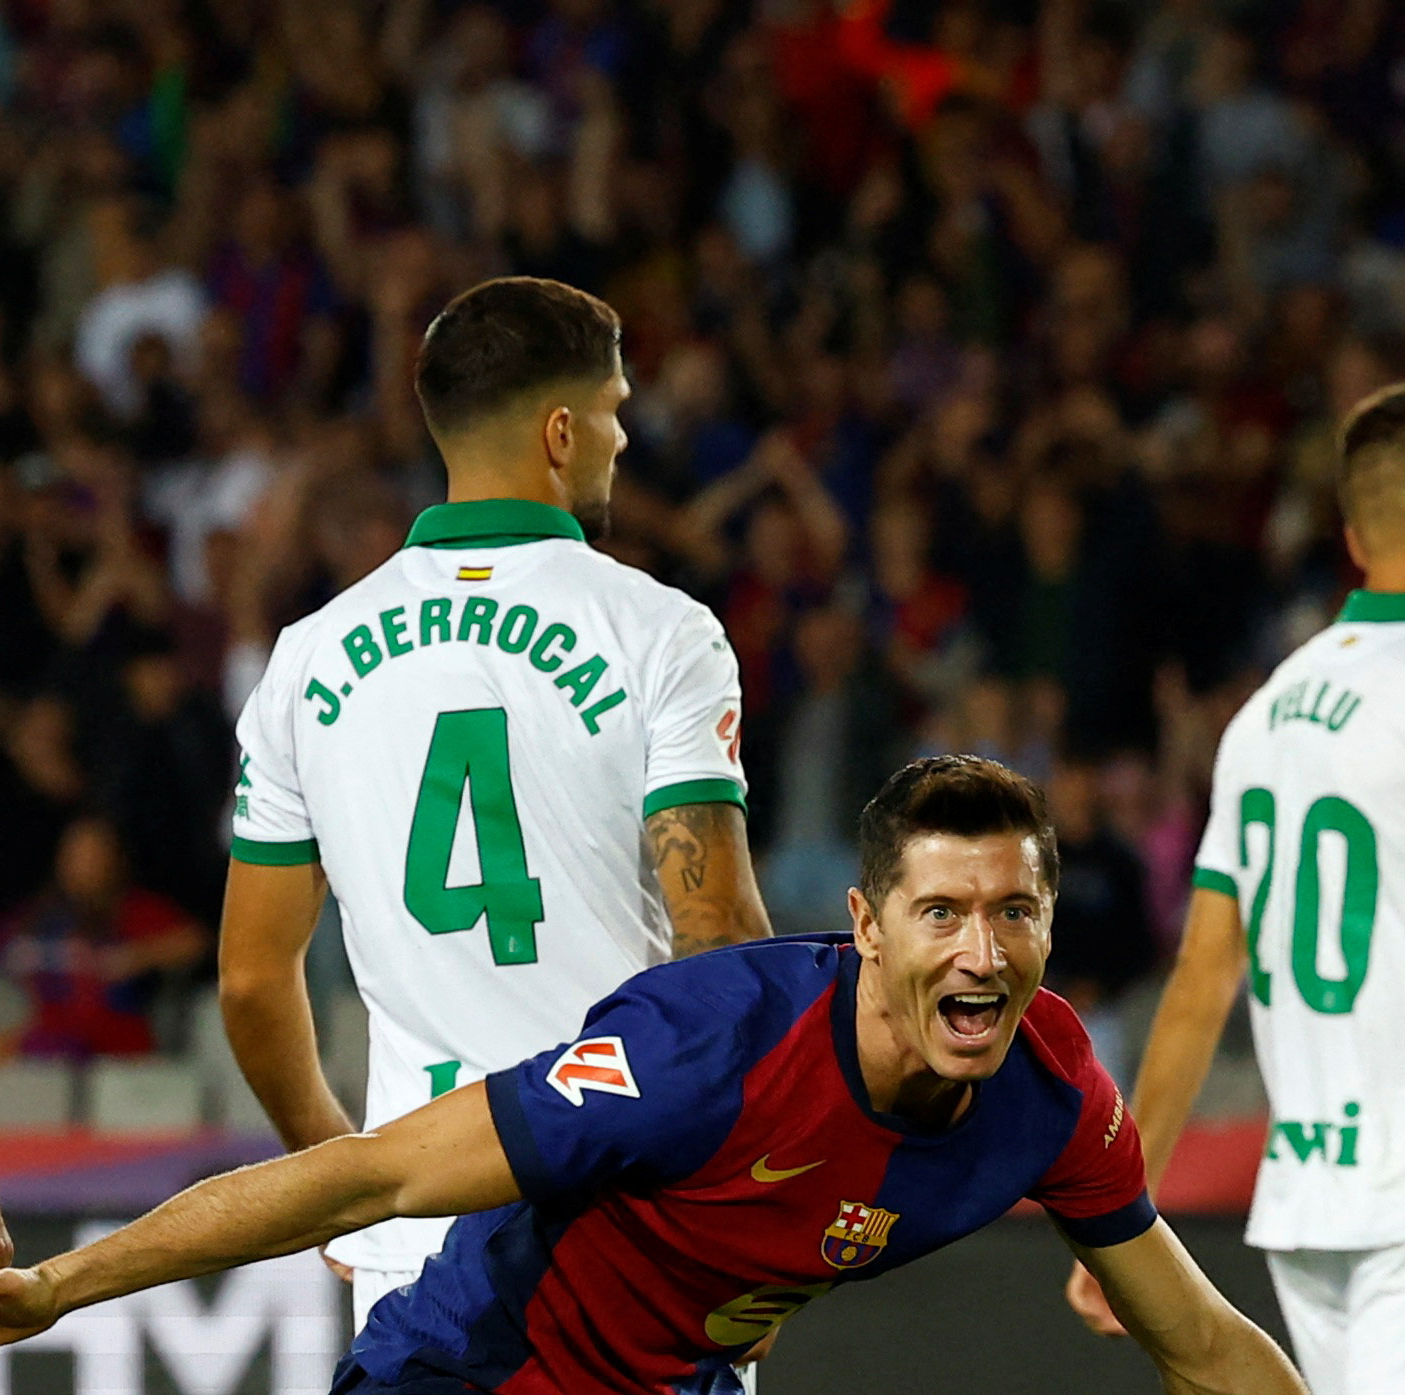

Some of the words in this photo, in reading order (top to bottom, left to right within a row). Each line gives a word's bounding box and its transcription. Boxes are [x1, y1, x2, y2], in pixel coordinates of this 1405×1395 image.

[404, 707, 544, 966] 4
[1239, 787, 1379, 1015] 20
[1267, 1101, 1360, 1166] wi
